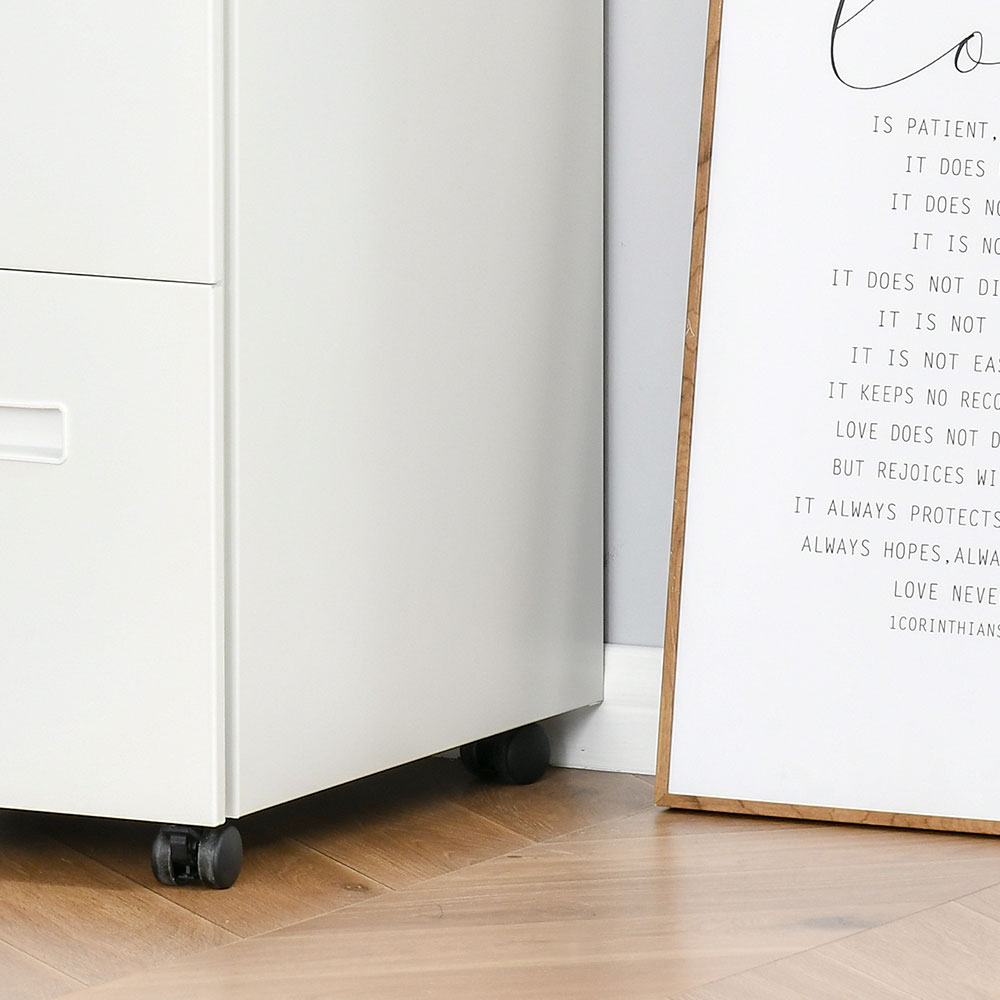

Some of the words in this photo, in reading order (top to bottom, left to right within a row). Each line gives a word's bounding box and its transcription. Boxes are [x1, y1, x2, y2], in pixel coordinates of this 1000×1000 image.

[872, 115, 893, 134] IS
[907, 117, 997, 142] PATIENT,
[905, 155, 927, 174] IT
[939, 157, 985, 178] DOES
[891, 192, 912, 211] IT
[925, 194, 971, 215] DOES
[912, 232, 934, 250] IT
[947, 234, 968, 254] IS
[831, 268, 854, 287] IT
[867, 271, 914, 292] DOES
[928, 275, 965, 294] NOT
[978, 278, 1000, 297] DI
[878, 309, 901, 328] IT
[915, 312, 937, 331] IS
[951, 314, 987, 334] NOT
[851, 346, 873, 365] IT
[888, 348, 909, 368] IS
[923, 351, 960, 370] NOT
[973, 354, 1000, 374] EA
[828, 381, 848, 399] IT
[860, 383, 914, 405] KEEPS
[926, 388, 948, 407] NO
[836, 420, 878, 440] LOVE
[890, 423, 934, 445] DOES
[946, 428, 979, 447] NOT
[832, 457, 865, 477] BUT
[877, 461, 964, 485] REJOICES
[977, 468, 997, 487] WI
[794, 495, 815, 514] IT
[827, 499, 897, 521] ALWAYS
[910, 504, 1000, 529] PROTECTS
[800, 535, 870, 557] ALWAYS
[894, 580, 939, 601] LOVE
[952, 584, 998, 606] NEVE
